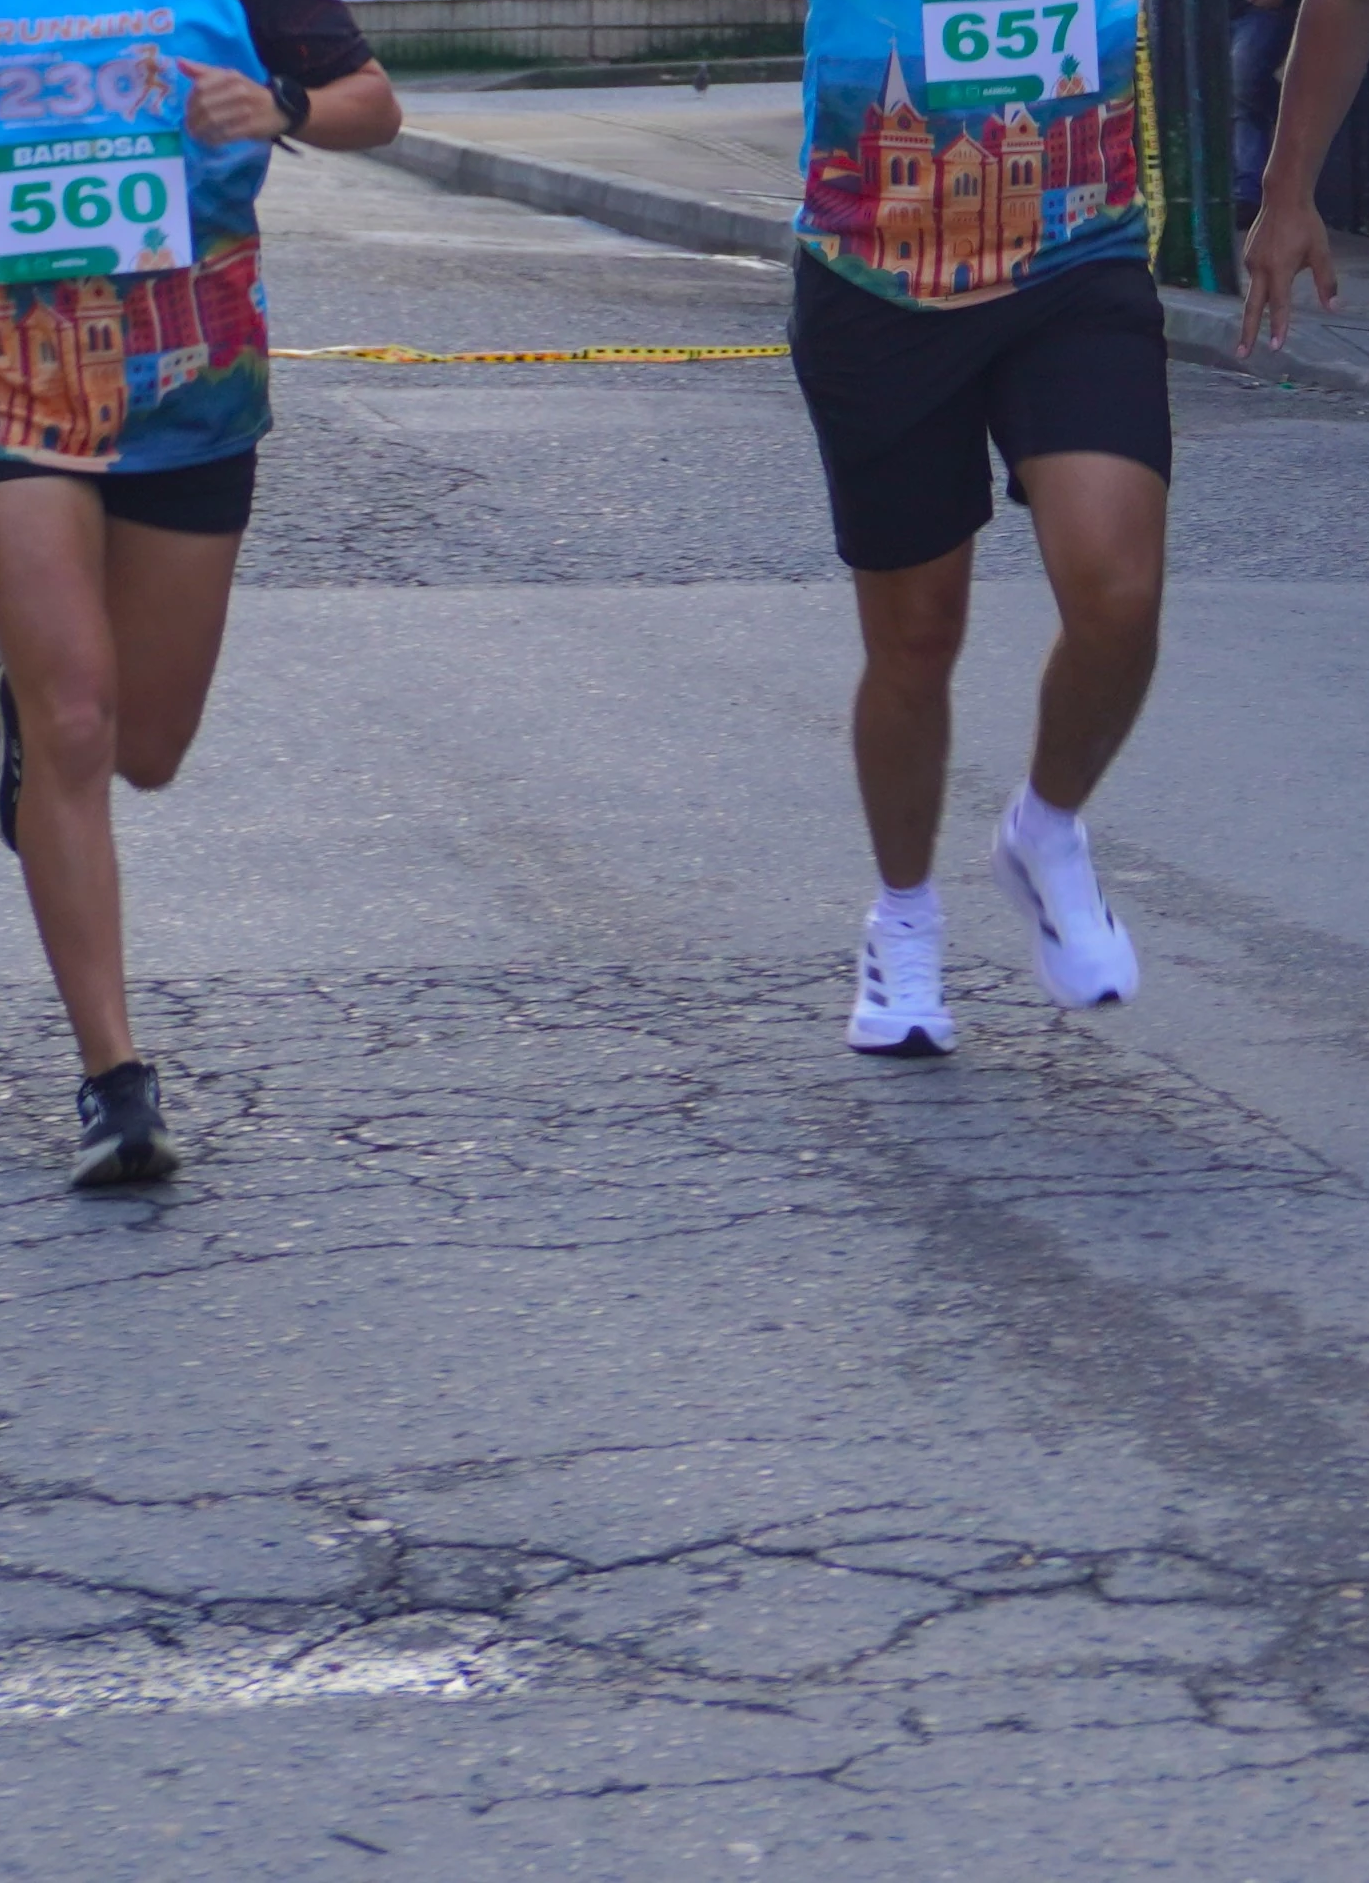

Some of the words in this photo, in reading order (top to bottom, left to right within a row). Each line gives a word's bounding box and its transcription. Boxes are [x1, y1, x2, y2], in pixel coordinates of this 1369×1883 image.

[942, 2, 1079, 62] 657
[13, 135, 154, 167] BARBOSA
[9, 172, 168, 235] 560
